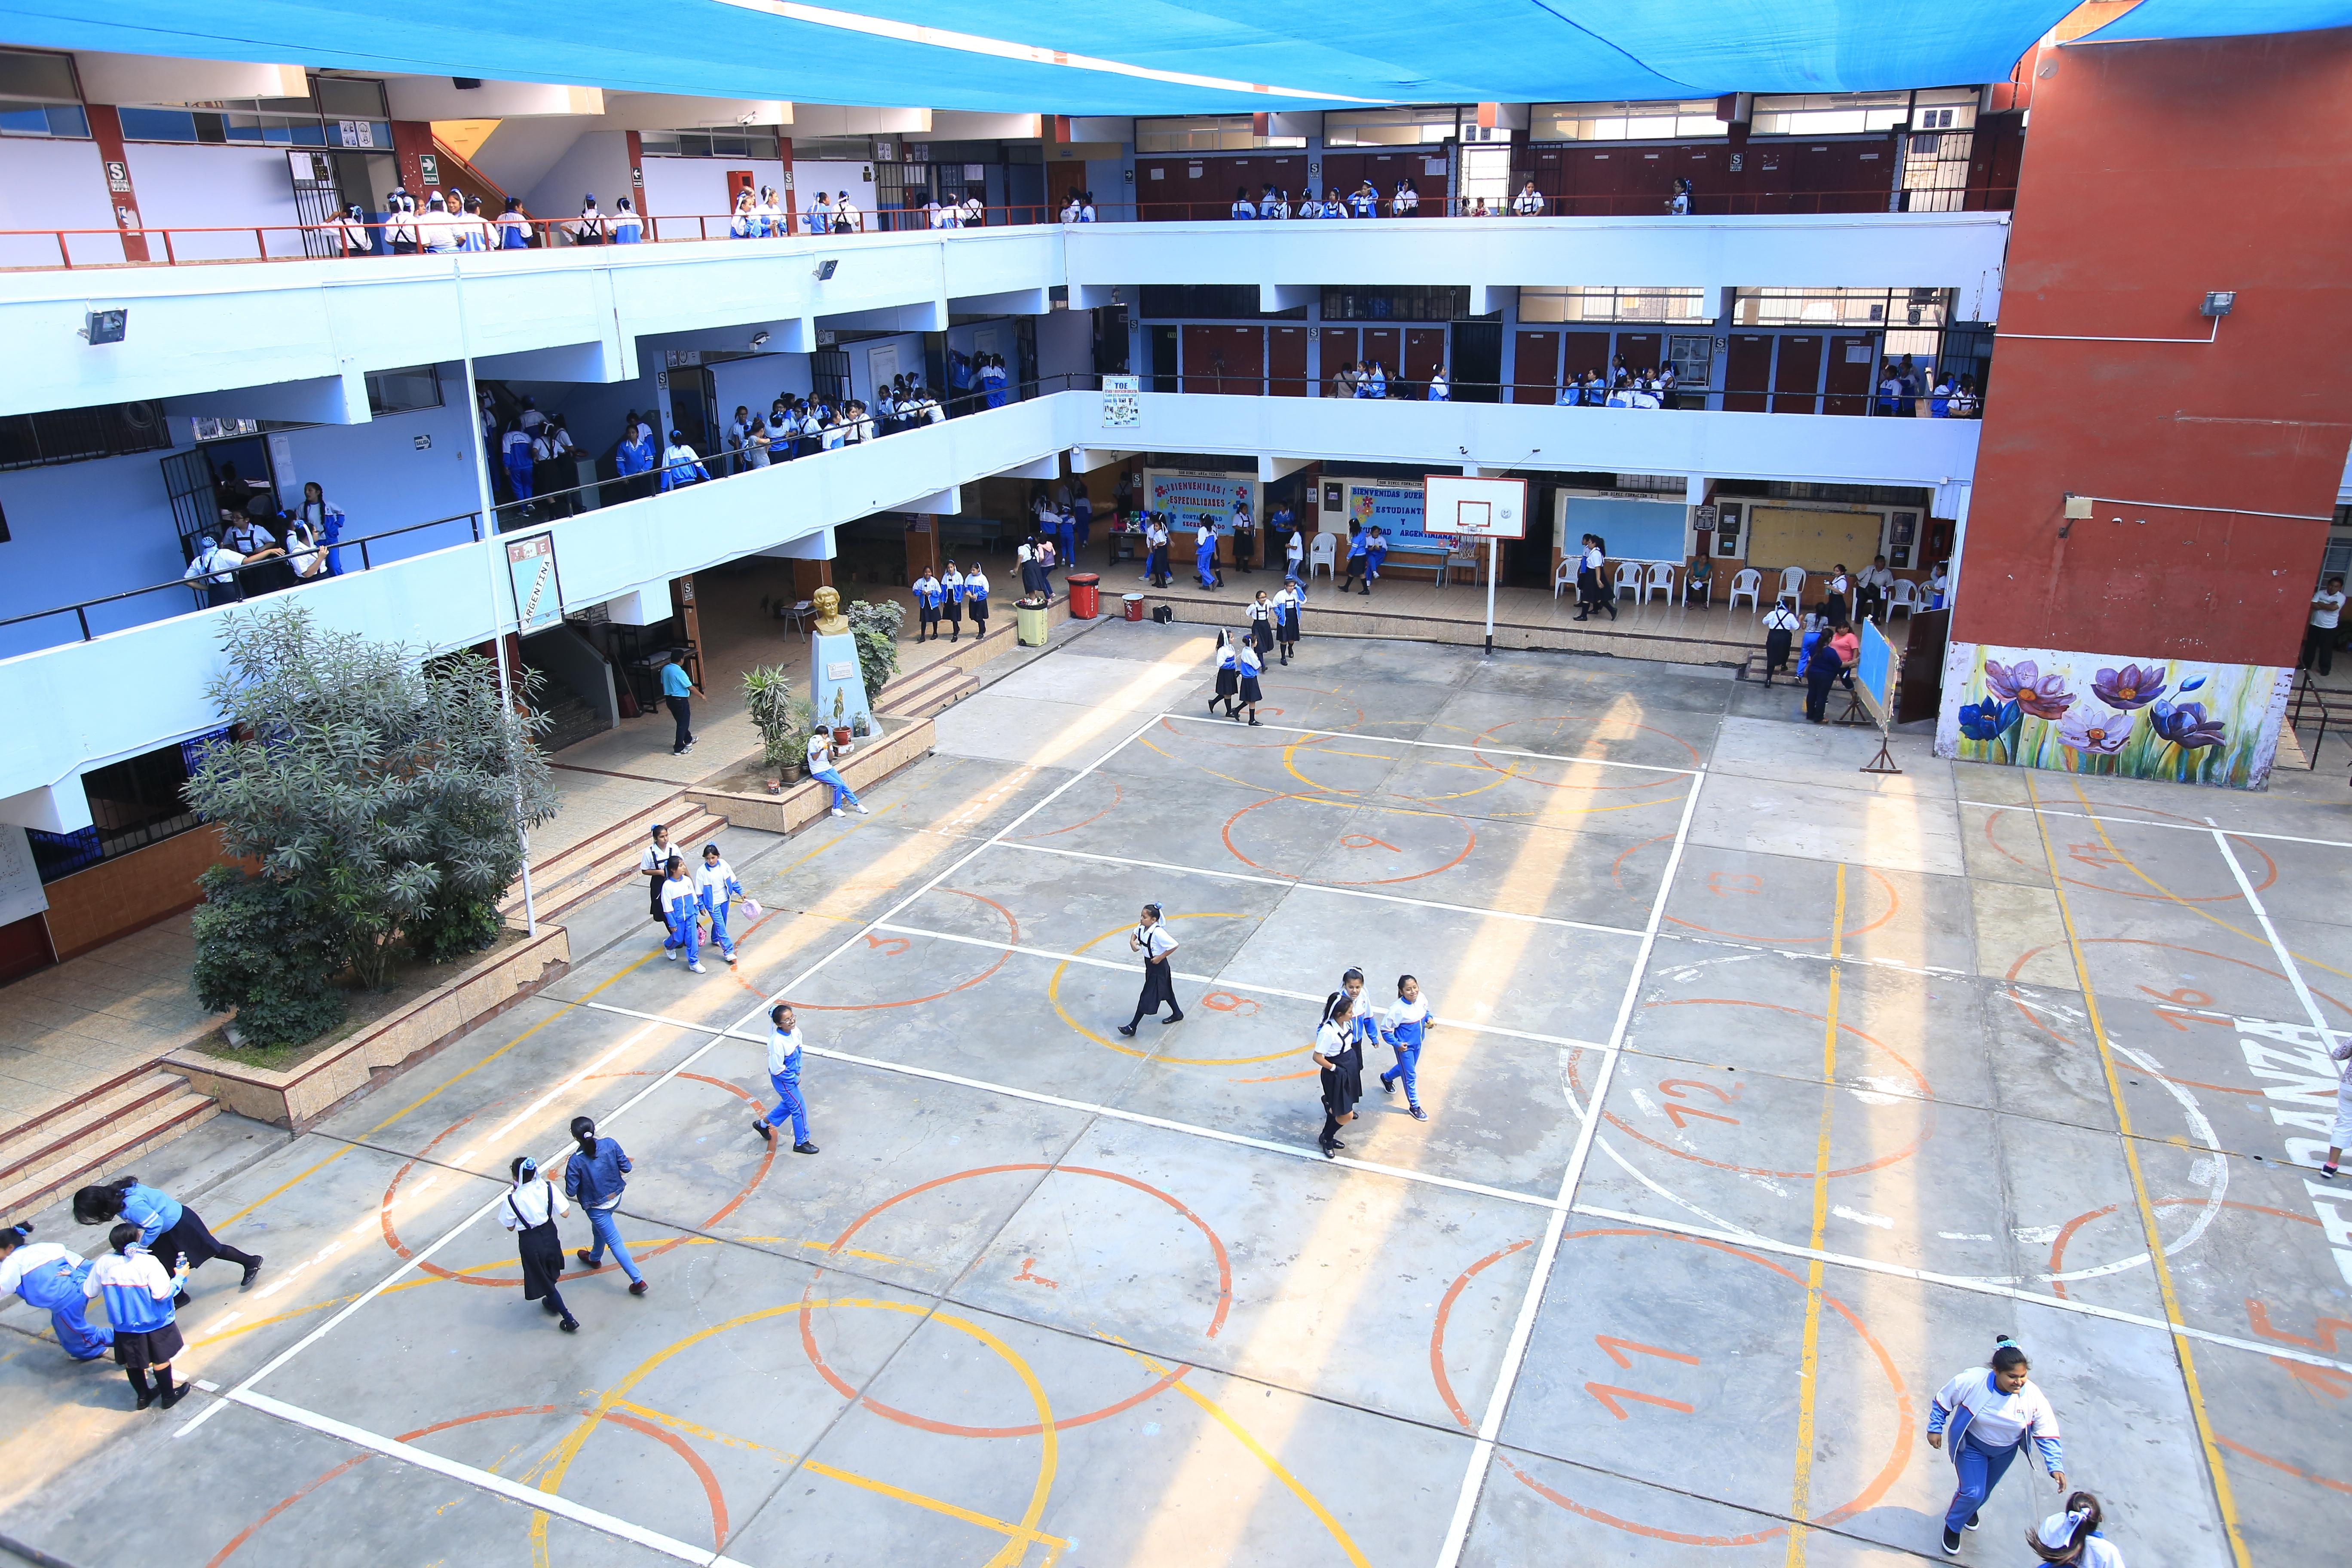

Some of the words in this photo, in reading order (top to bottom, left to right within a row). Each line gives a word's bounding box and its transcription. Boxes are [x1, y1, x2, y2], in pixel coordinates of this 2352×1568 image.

[1733, 154, 1740, 164] S
[110, 164, 124, 180] S
[786, 173, 792, 183] S
[1717, 338, 1724, 347] S
[659, 373, 665, 383] S
[1353, 488, 1400, 498] BIENVENIDAS
[1170, 496, 1225, 507] ESPECIALIDADES
[539, 543, 547, 553] E
[526, 561, 550, 624] ARGENTINA
[685, 583, 691, 593] S
[2067, 842, 2134, 869] 17
[1708, 870, 1763, 898] 13
[2135, 984, 2236, 1032] 16
[1658, 1078, 1745, 1129] 12
[1584, 1334, 1700, 1421] 11
